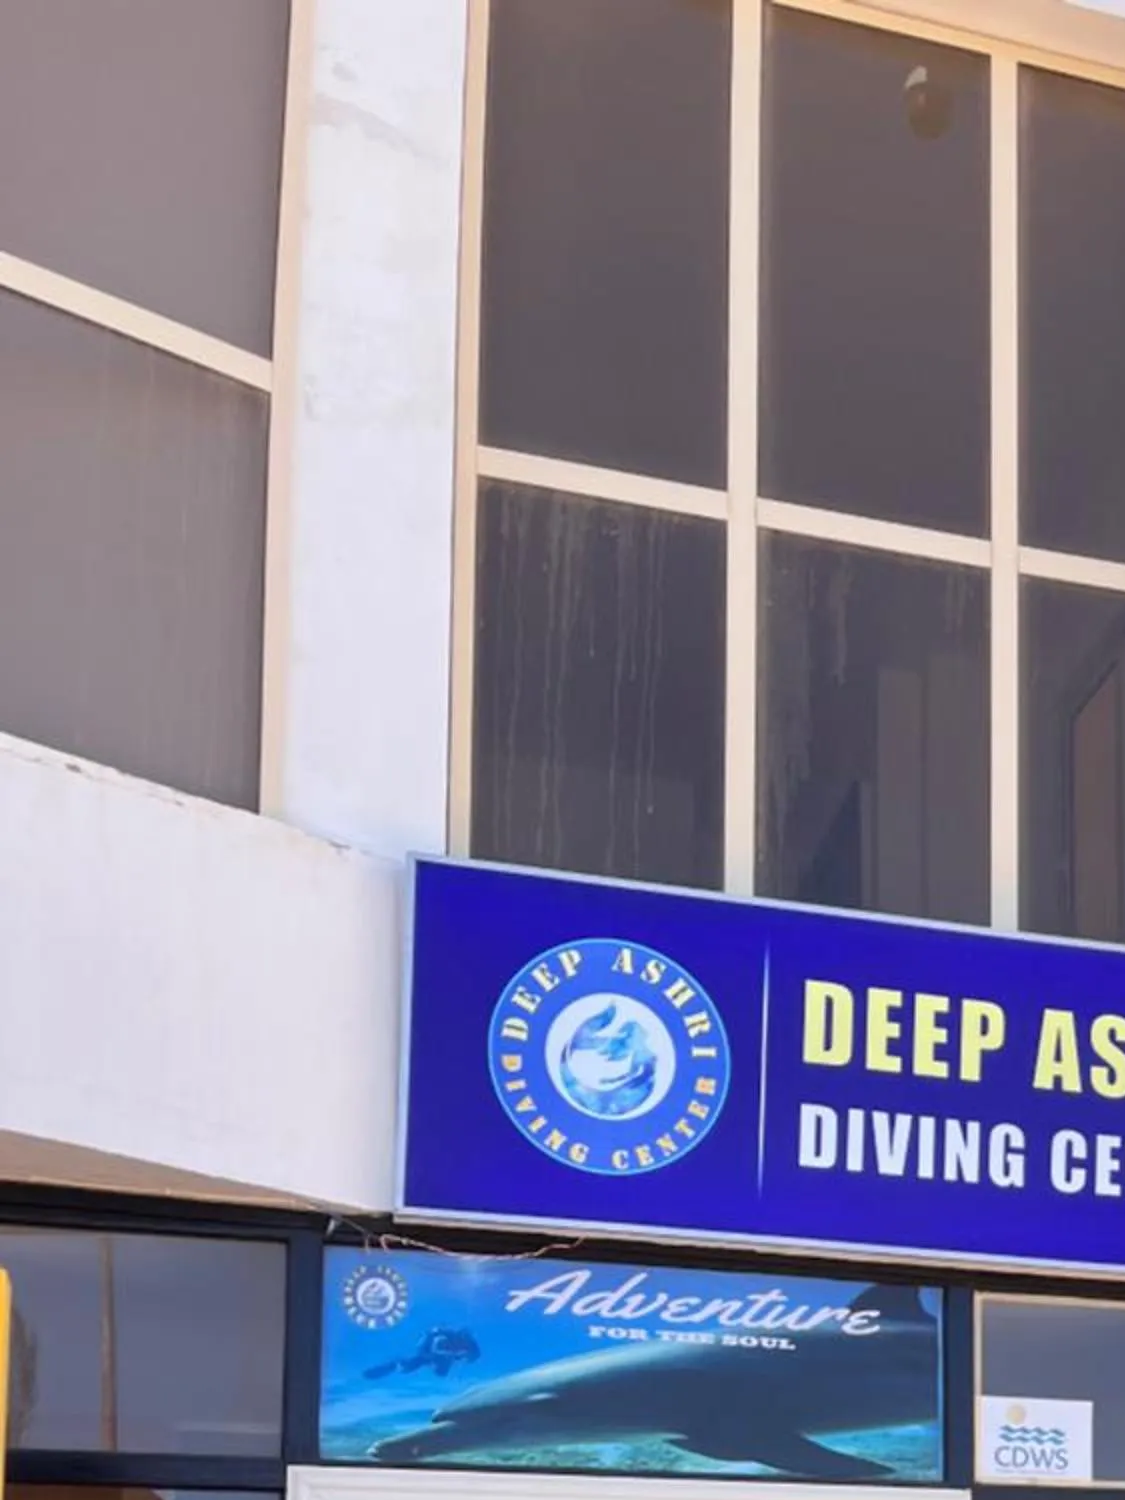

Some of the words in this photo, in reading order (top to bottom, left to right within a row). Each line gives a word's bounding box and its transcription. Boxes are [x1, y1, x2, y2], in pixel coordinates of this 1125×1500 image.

[501, 948, 582, 1042] DEEP
[611, 948, 717, 1058] ASHRI
[803, 979, 1005, 1082] DEEP
[501, 1055, 590, 1163] DIVING
[612, 1077, 716, 1170] CENTER
[799, 1103, 1025, 1187] DIVING
[504, 1269, 881, 1336] Adventure
[589, 1325, 649, 1341] FOR
[656, 1328, 717, 1345] THE
[721, 1333, 796, 1350] SOUL
[994, 1445, 1069, 1470] CDWS
